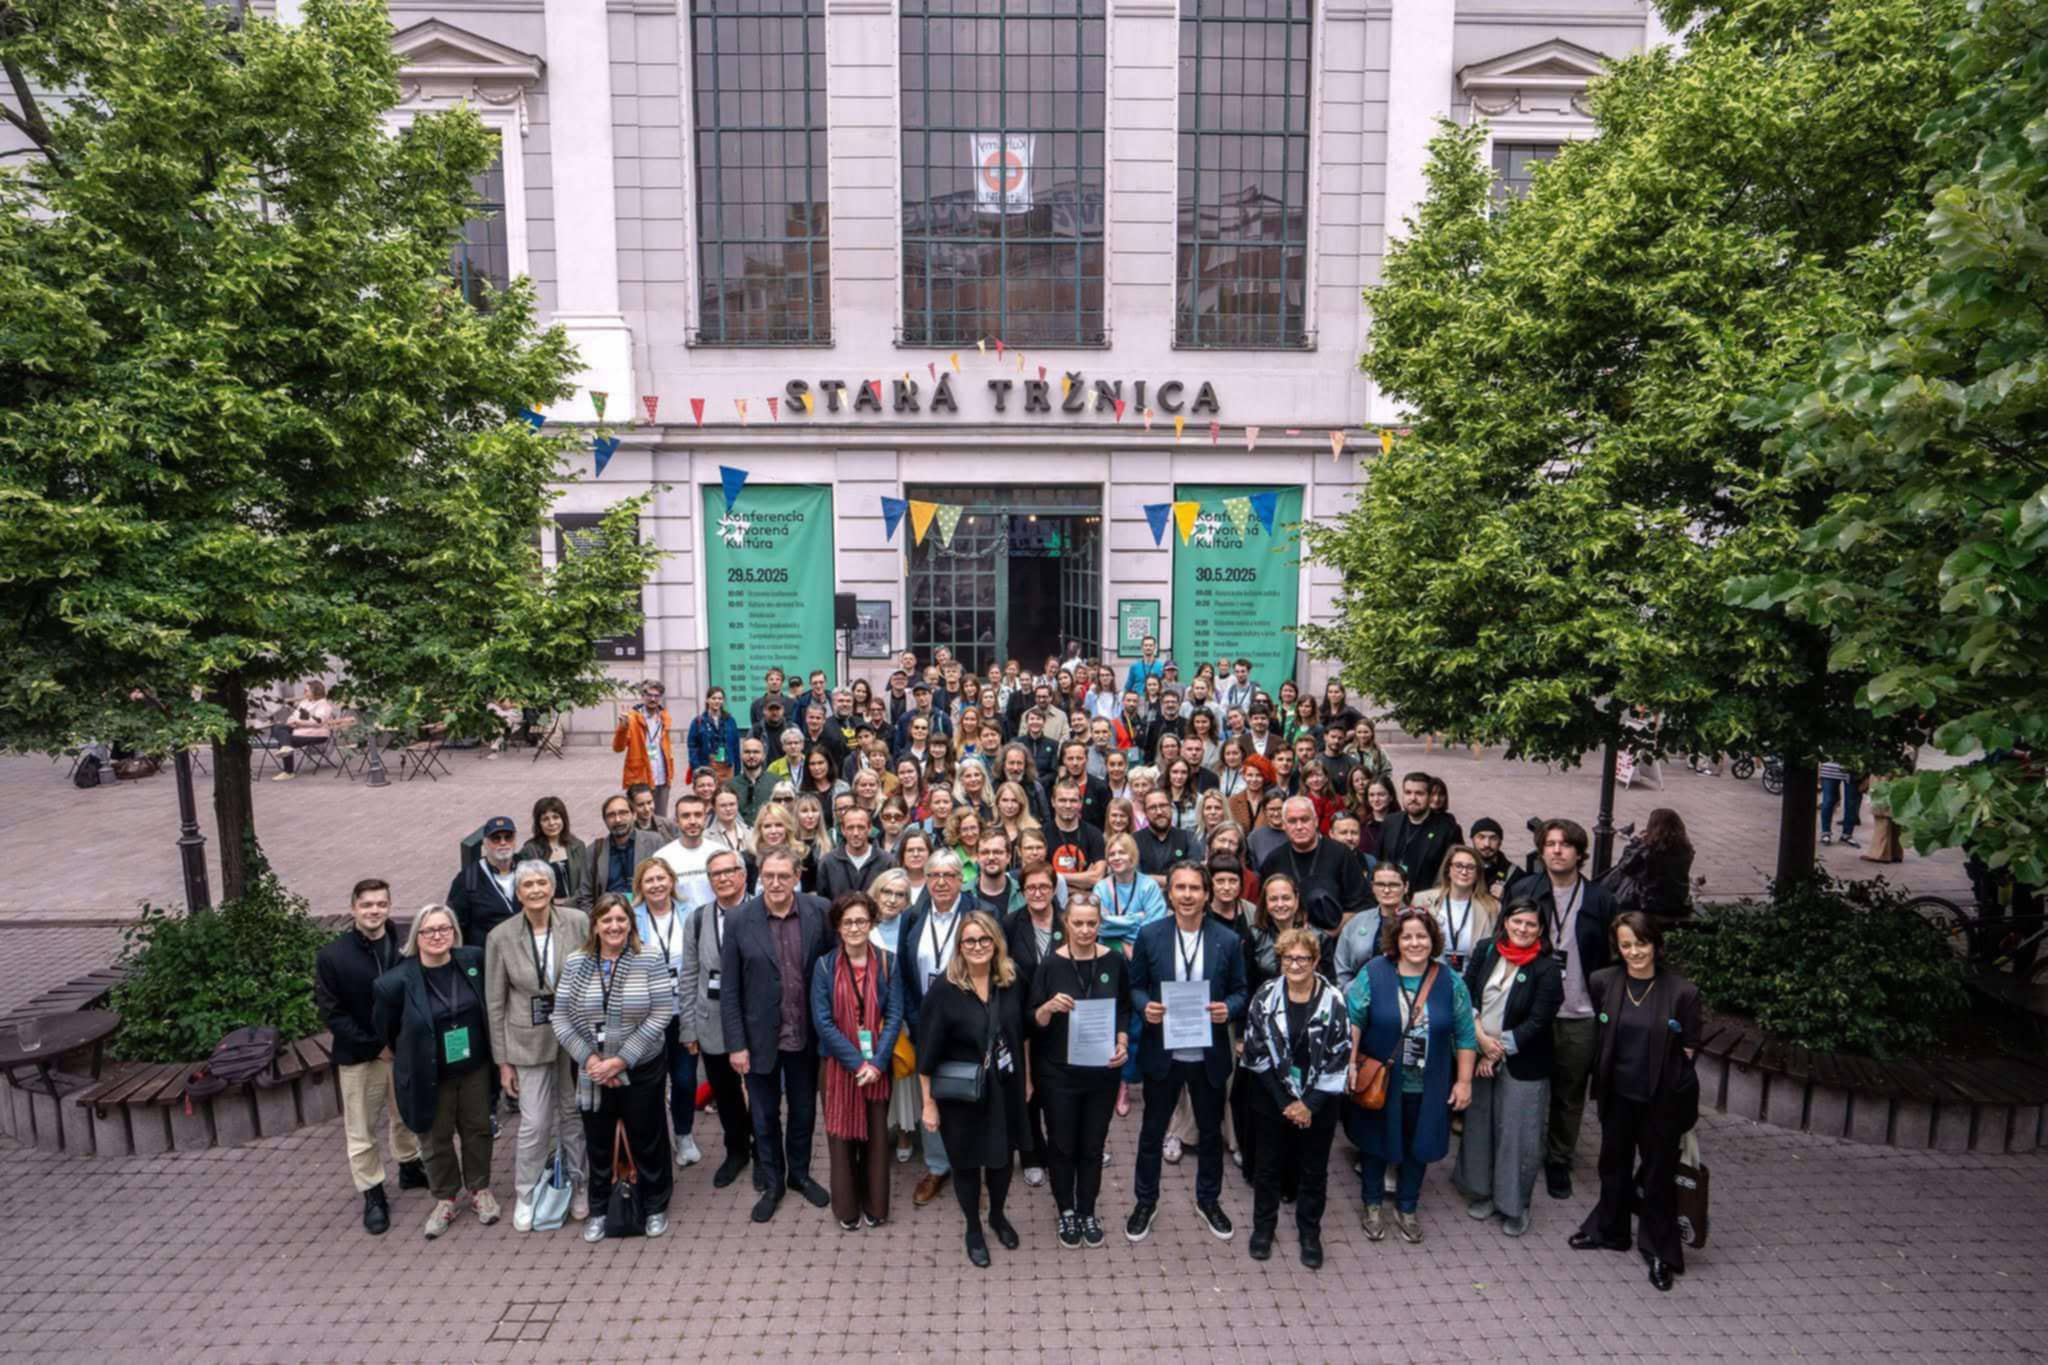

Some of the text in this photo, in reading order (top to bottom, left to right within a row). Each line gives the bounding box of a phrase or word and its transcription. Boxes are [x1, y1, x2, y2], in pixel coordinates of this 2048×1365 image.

[785, 371, 1221, 413] STARÁ TRŽNICA
[726, 510, 804, 522] Konferencia
[726, 536, 773, 549] Kultúra
[1196, 537, 1243, 549] Kultúra
[728, 567, 788, 583] 29.5.2025
[1196, 567, 1256, 582] 30.5.2025
